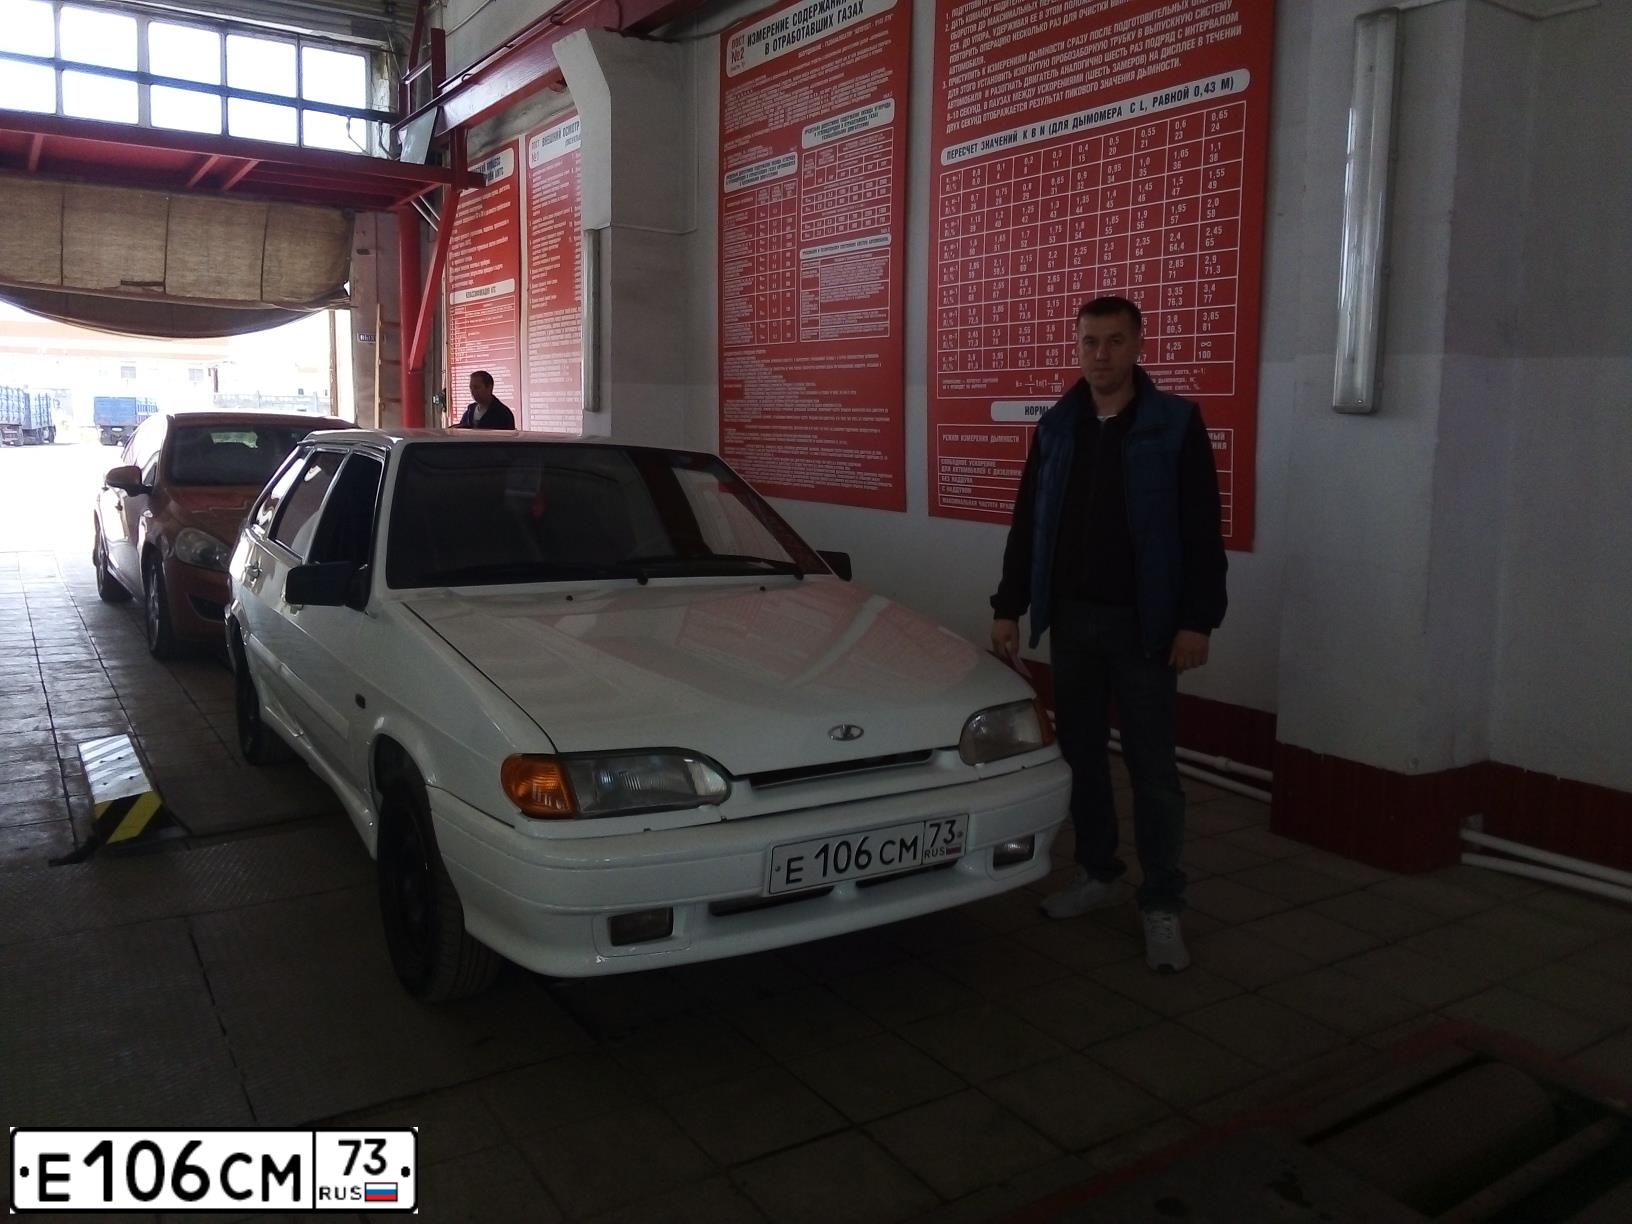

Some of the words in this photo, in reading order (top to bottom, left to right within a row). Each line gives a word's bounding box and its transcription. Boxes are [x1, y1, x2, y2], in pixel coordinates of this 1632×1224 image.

[765, 43, 770, 55] В
[773, 14, 834, 51] ОТРАБОТАВШИХ
[838, 0, 863, 24] ГАЗАХ
[1067, 33, 1088, 48] СРАЗУ
[1090, 26, 1112, 40] ПОСЛЕ
[1114, 0, 1188, 33] ПОДГОТОВИТЕЛЬНЫХ
[1110, 30, 1136, 47] ТРУБКУ
[1138, 28, 1142, 38] В
[1144, 12, 1193, 36] ВЫПУСКНУЮ
[1195, 0, 1232, 19] СИСТЕМУ
[747, 16, 789, 47] ИЗМЕРЕНИЕ
[1013, 22, 1047, 41] НЕСКОЛЬКО
[1050, 17, 1061, 29] РАЗ
[1024, 69, 1058, 88] ДВИГАТЕЛЬ
[1061, 55, 1102, 74] АНАЛОГИЧНО
[1105, 47, 1127, 61] ШЕСТЬ
[1130, 42, 1143, 54] РАЗ
[1145, 31, 1175, 49] ПОДРЯД
[1178, 29, 1182, 38] С
[1185, 12, 1239, 36] ИНТЕРВАЛОМ
[1013, 88, 1035, 101] МЕЖДУ
[1113, 54, 1147, 72] ЗАМЕРОВ)
[1149, 50, 1158, 61] НА
[1161, 39, 1195, 60] ДИСПЛЕЕ
[1198, 36, 1203, 47] В
[1206, 25, 1242, 44] ТЕЧЕНИИ
[983, 102, 1027, 121] ОТОБРАЖАЕТСЯ
[1029, 94, 1063, 110] РЕЗУЛЬТАТ
[1065, 82, 1098, 98] ПИКОВОГО
[1100, 71, 1135, 89] ЗНАЧЕНИЯ
[946, 144, 977, 160] ПЕРЕСЧЕТ
[981, 131, 1018, 151] ЗНАЧЕНИЙ
[1049, 119, 1069, 135] (ДЛЯ
[1072, 106, 1122, 130] ДЫМОМЕРА
[1152, 86, 1190, 108] РАВНОЙ
[1194, 81, 1216, 97] 0,43
[1221, 76, 1234, 91] М)
[1212, 109, 1228, 121] 0,65
[1175, 120, 1186, 130] 0,6
[1211, 122, 1220, 132] 24
[1175, 131, 1183, 140] 23
[1211, 142, 1221, 152] 1,1
[1174, 148, 1189, 159] 1,05
[1209, 152, 1218, 162] 38
[1173, 160, 1181, 170] 36
[1209, 168, 1226, 179] 1,55
[1173, 176, 1184, 187] 1,5
[1208, 180, 1217, 189] 49
[1172, 187, 1180, 196] 47
[1208, 197, 1220, 208] 2,0
[1172, 204, 1187, 214] 1,95
[1207, 209, 1216, 218] 58
[1170, 215, 1179, 224] 57
[1170, 232, 1181, 241] 2,4
[1206, 226, 1224, 237] 2,45
[1170, 242, 1184, 252] 64,4
[1205, 238, 1215, 247] 65
[1169, 259, 1184, 269] 2,85
[1204, 255, 1216, 265] 2,9
[1169, 270, 1176, 278] 71
[1204, 265, 1221, 274] 71,3
[1168, 286, 1183, 296] 3,35
[1204, 283, 1216, 294] 3,4
[1168, 297, 1182, 307] 76,3
[1204, 294, 1212, 303] 77
[1167, 314, 1178, 324] 3,8
[1203, 311, 1220, 321] 3,85
[1166, 324, 1182, 334] 80,5
[1202, 322, 1210, 331] 81
[1166, 342, 1182, 351] 4,25
[1166, 352, 1174, 360] 84
[1198, 350, 1212, 359] 100
[930, 820, 956, 847] 73
[924, 846, 945, 859] RUS
